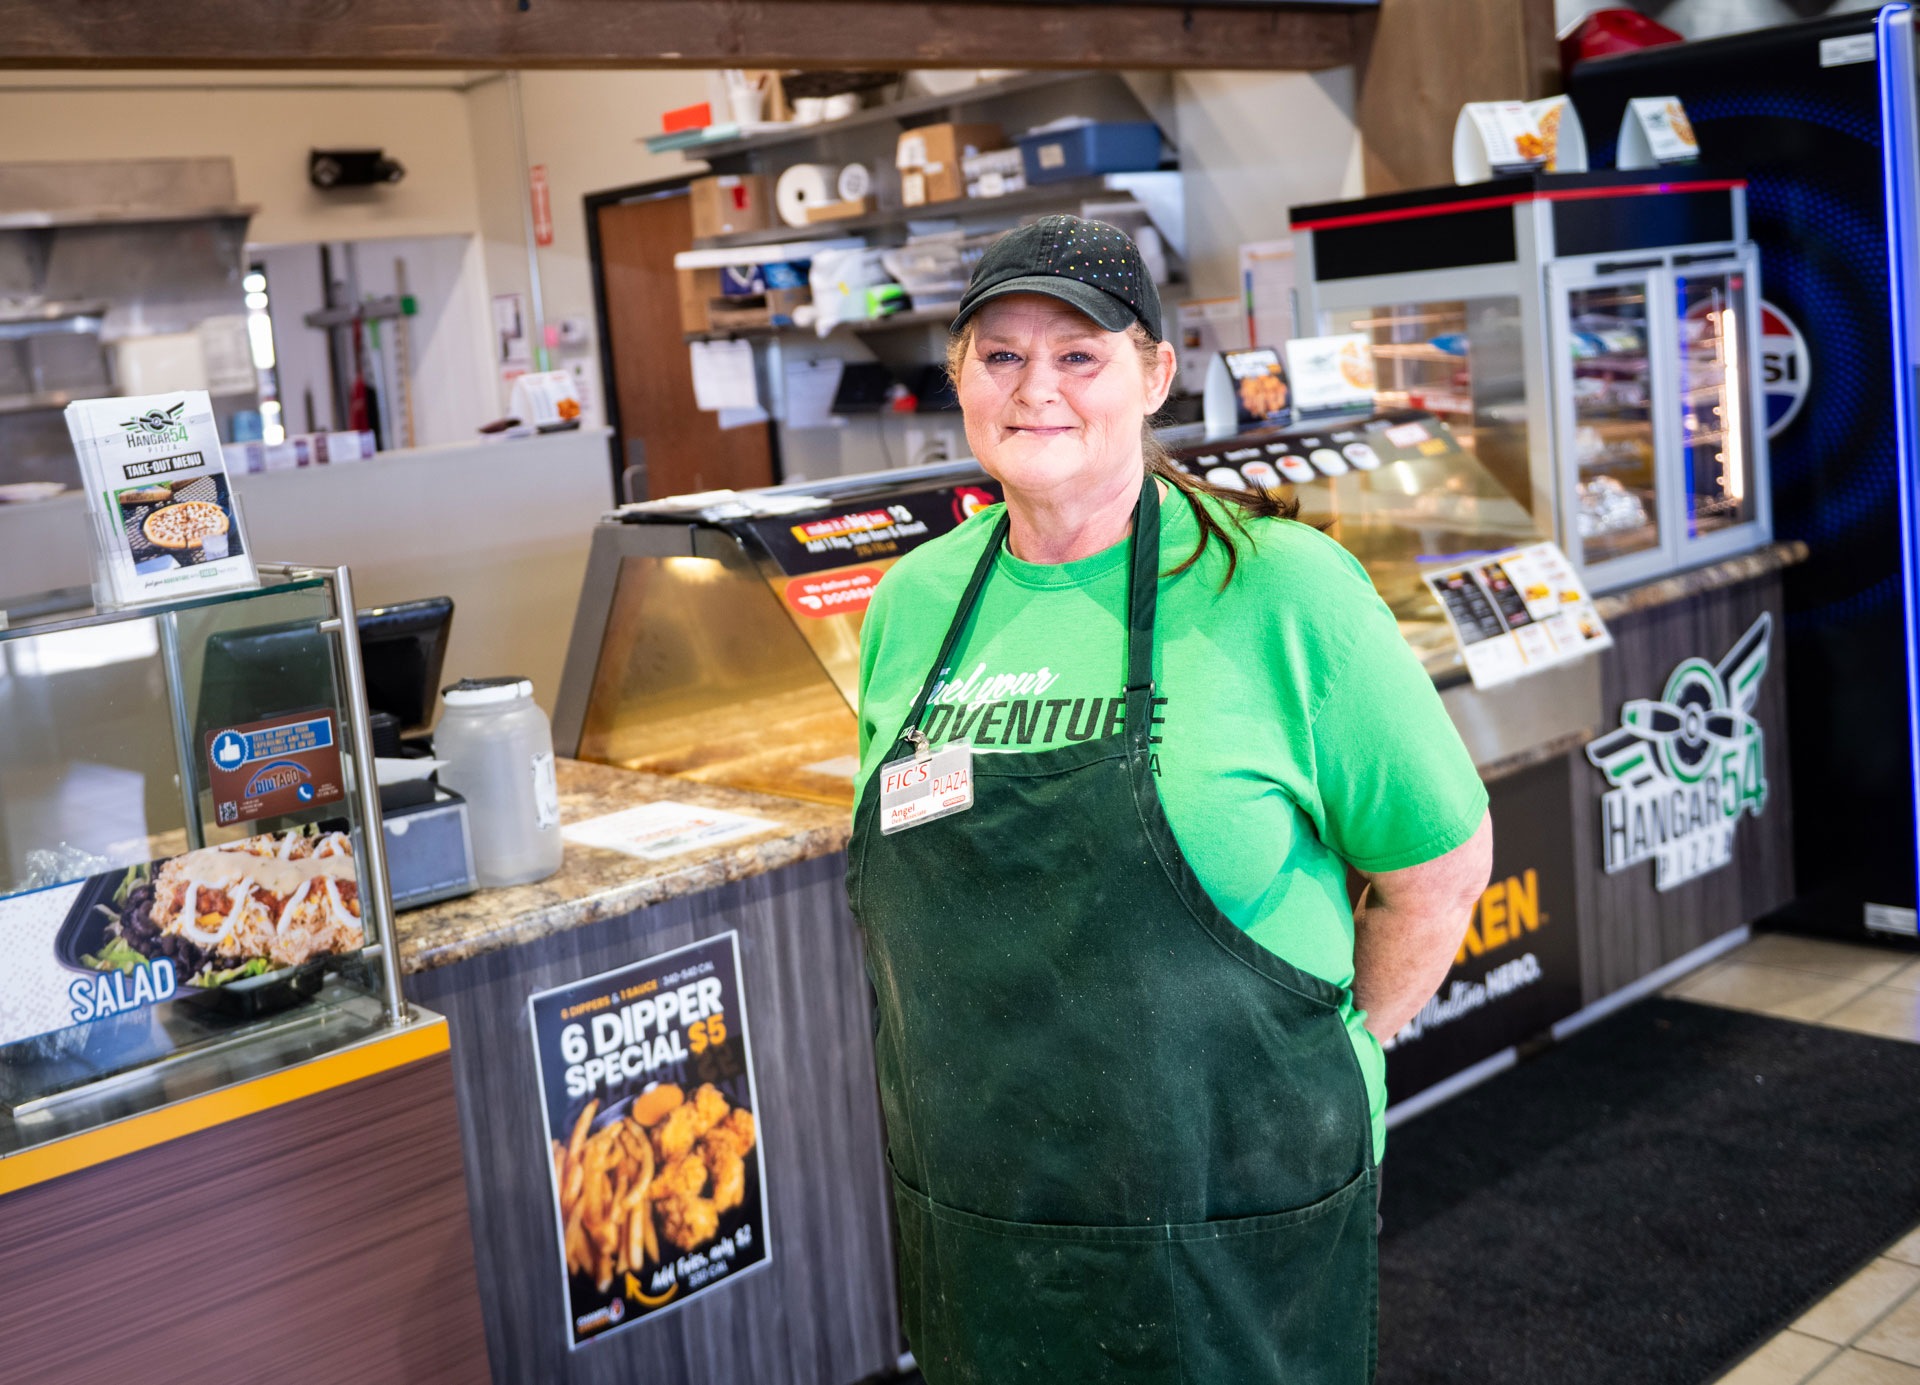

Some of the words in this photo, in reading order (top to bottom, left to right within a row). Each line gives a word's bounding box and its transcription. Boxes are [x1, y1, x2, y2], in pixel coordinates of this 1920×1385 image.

[125, 458, 171, 478] TAKE-OUT
[171, 453, 202, 470] MENU
[803, 583, 821, 594] We
[821, 578, 851, 591] deliver
[850, 574, 872, 587] with
[822, 584, 878, 606] DOORDA
[966, 665, 1061, 712] your
[252, 734, 265, 742] TELL
[265, 731, 274, 740] US
[275, 728, 294, 738] ABOUT
[295, 725, 309, 734] YOUR
[253, 737, 286, 750] EXPERIENCE
[287, 734, 300, 743] AND
[301, 731, 315, 740] YOUR
[254, 749, 269, 758] MEAL
[270, 744, 289, 755] COULD
[289, 742, 297, 751] BE
[297, 740, 307, 749] ON
[255, 768, 300, 795] bluTACO
[886, 763, 928, 793] FIC'S
[932, 769, 968, 798] PLAZA
[891, 802, 915, 819] Angel
[903, 809, 927, 821] Associate
[1658, 828, 1733, 877] PIZZA
[69, 956, 177, 1025] SALAD
[569, 995, 612, 1018] DIPPERS
[626, 979, 659, 1000] SAUCE
[560, 1022, 589, 1065] 6
[591, 975, 725, 1057] DIPPER
[564, 1029, 689, 1098] SPECIAL
[687, 1012, 727, 1054] $5
[651, 1262, 676, 1291] Add
[709, 1236, 736, 1260] only
[734, 1222, 752, 1249] $2
